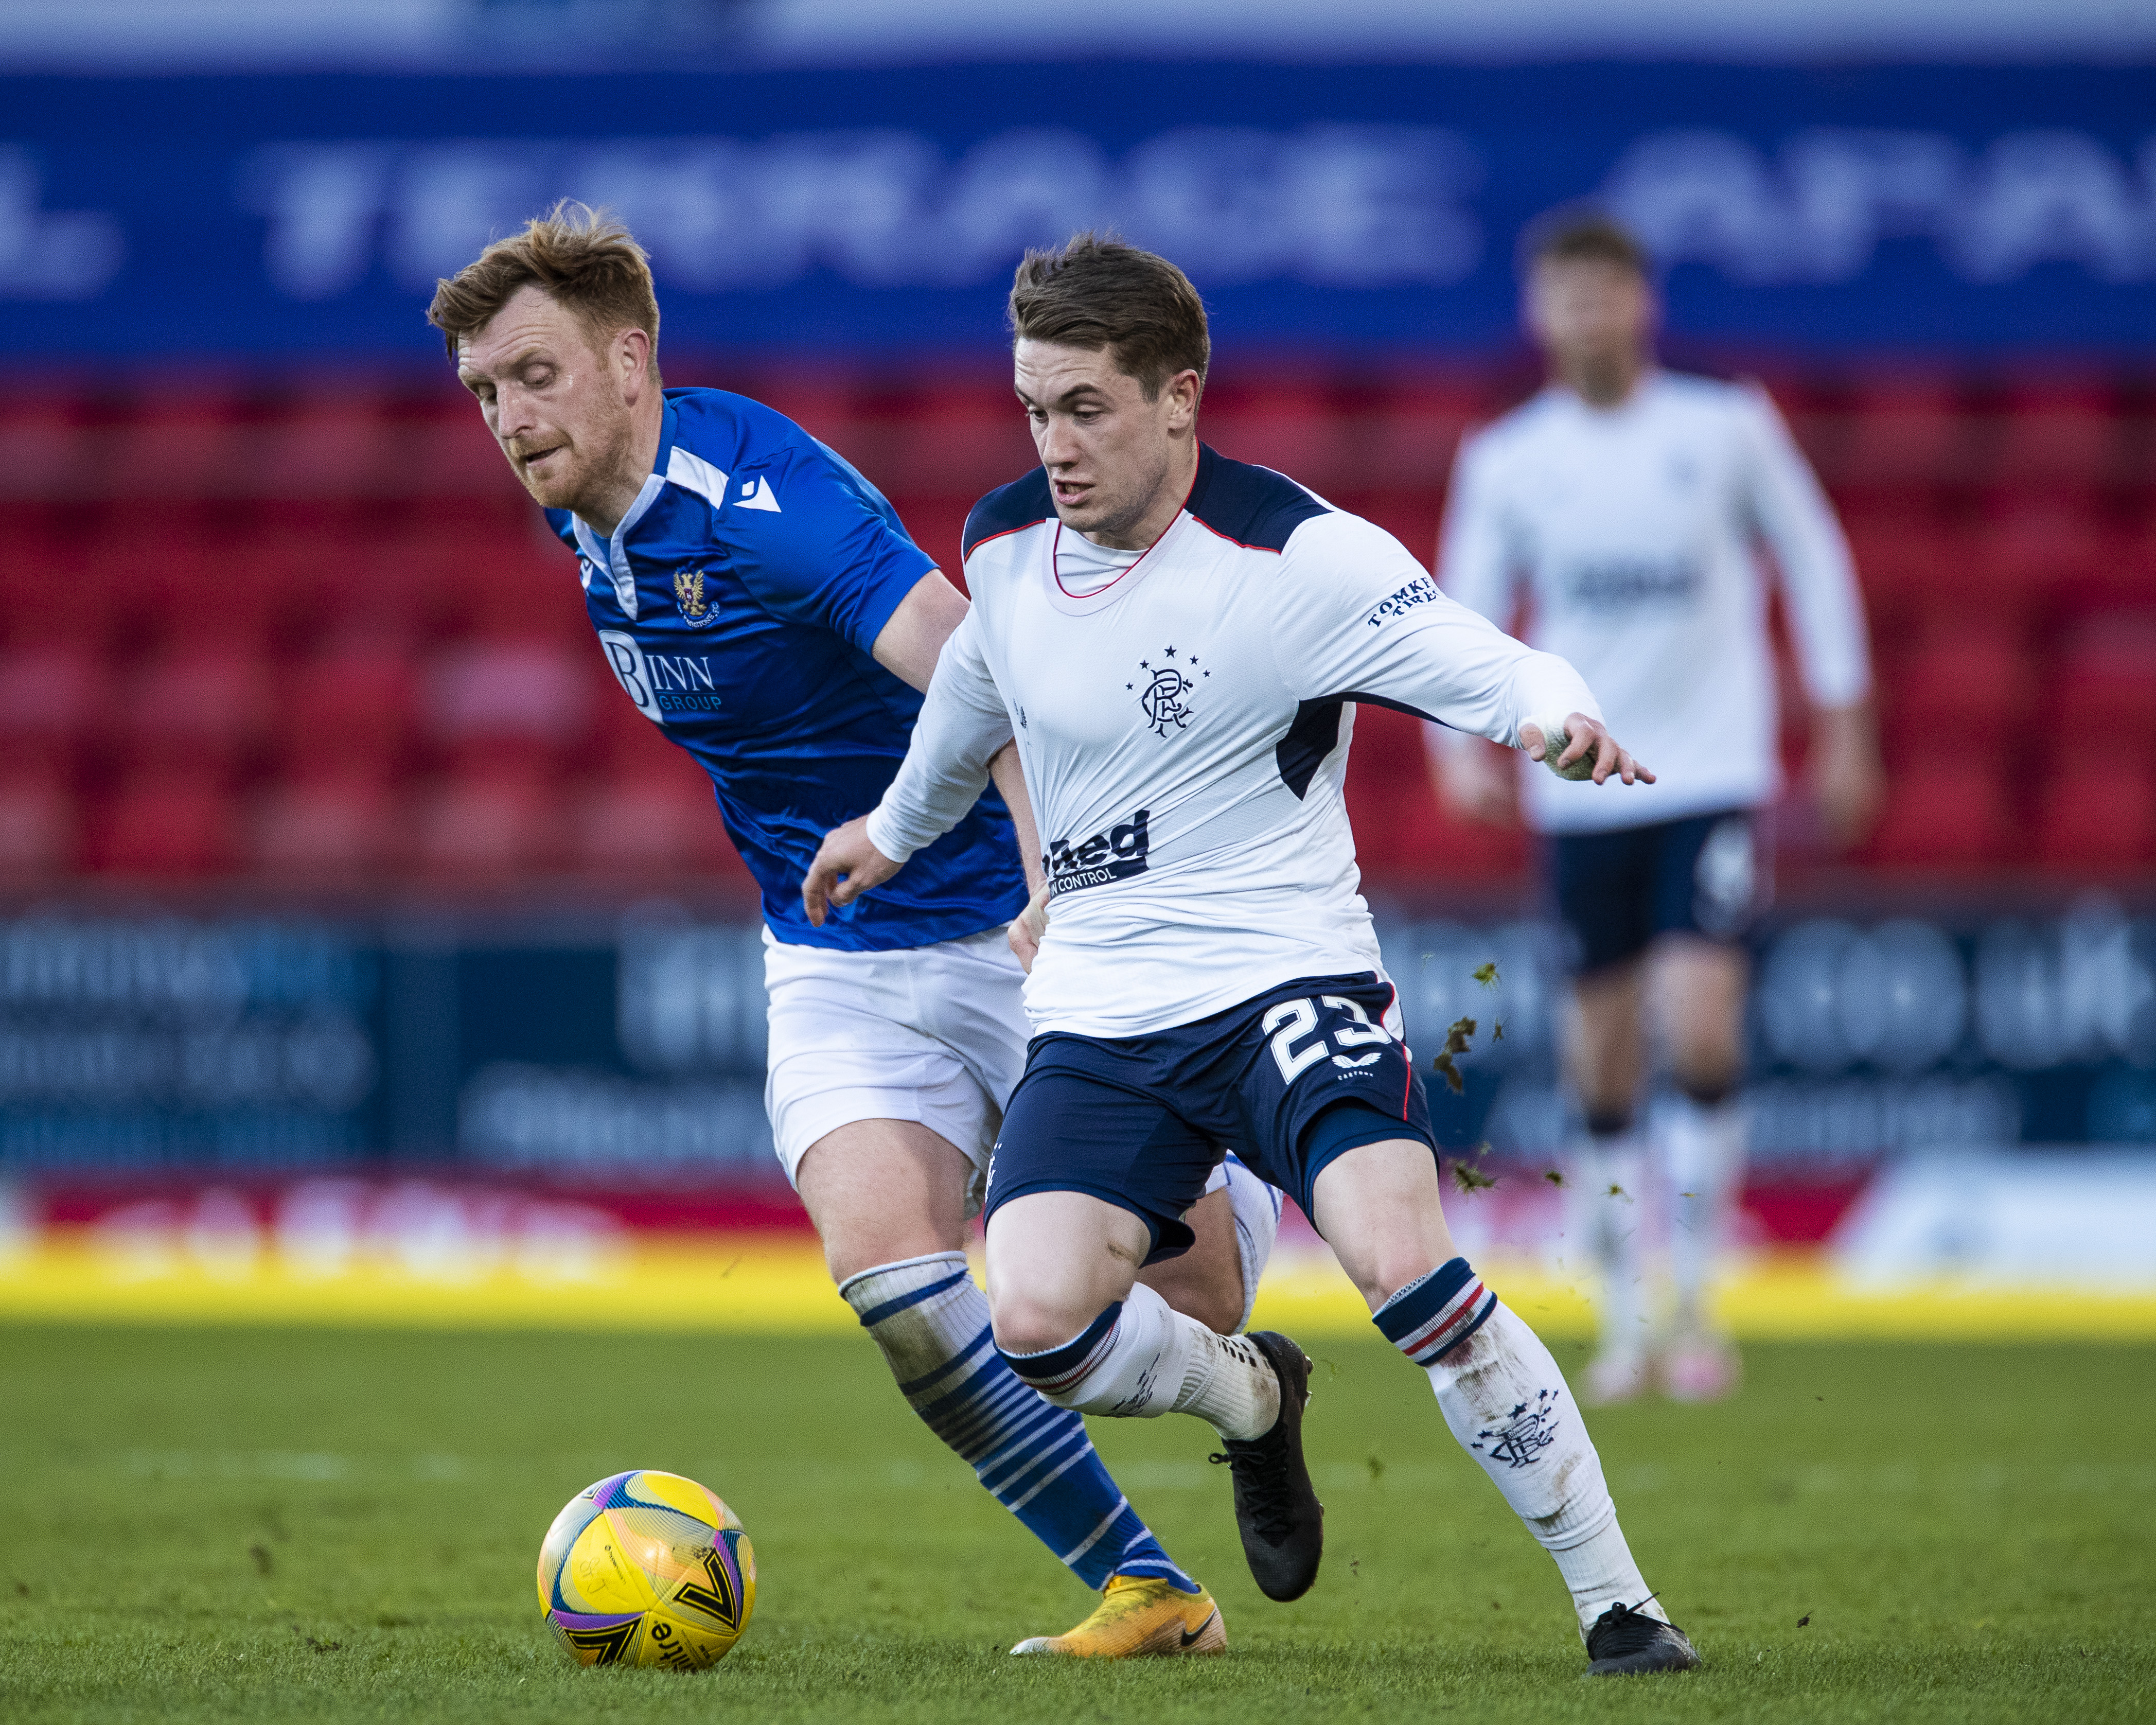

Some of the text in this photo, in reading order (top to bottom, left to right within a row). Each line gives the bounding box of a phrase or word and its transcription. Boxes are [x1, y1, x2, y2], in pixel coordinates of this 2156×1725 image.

[605, 641, 715, 708] BINN
[659, 695, 721, 710] GROUP
[1058, 868, 1117, 892] CONTROL
[1262, 994, 1392, 1085] 23
